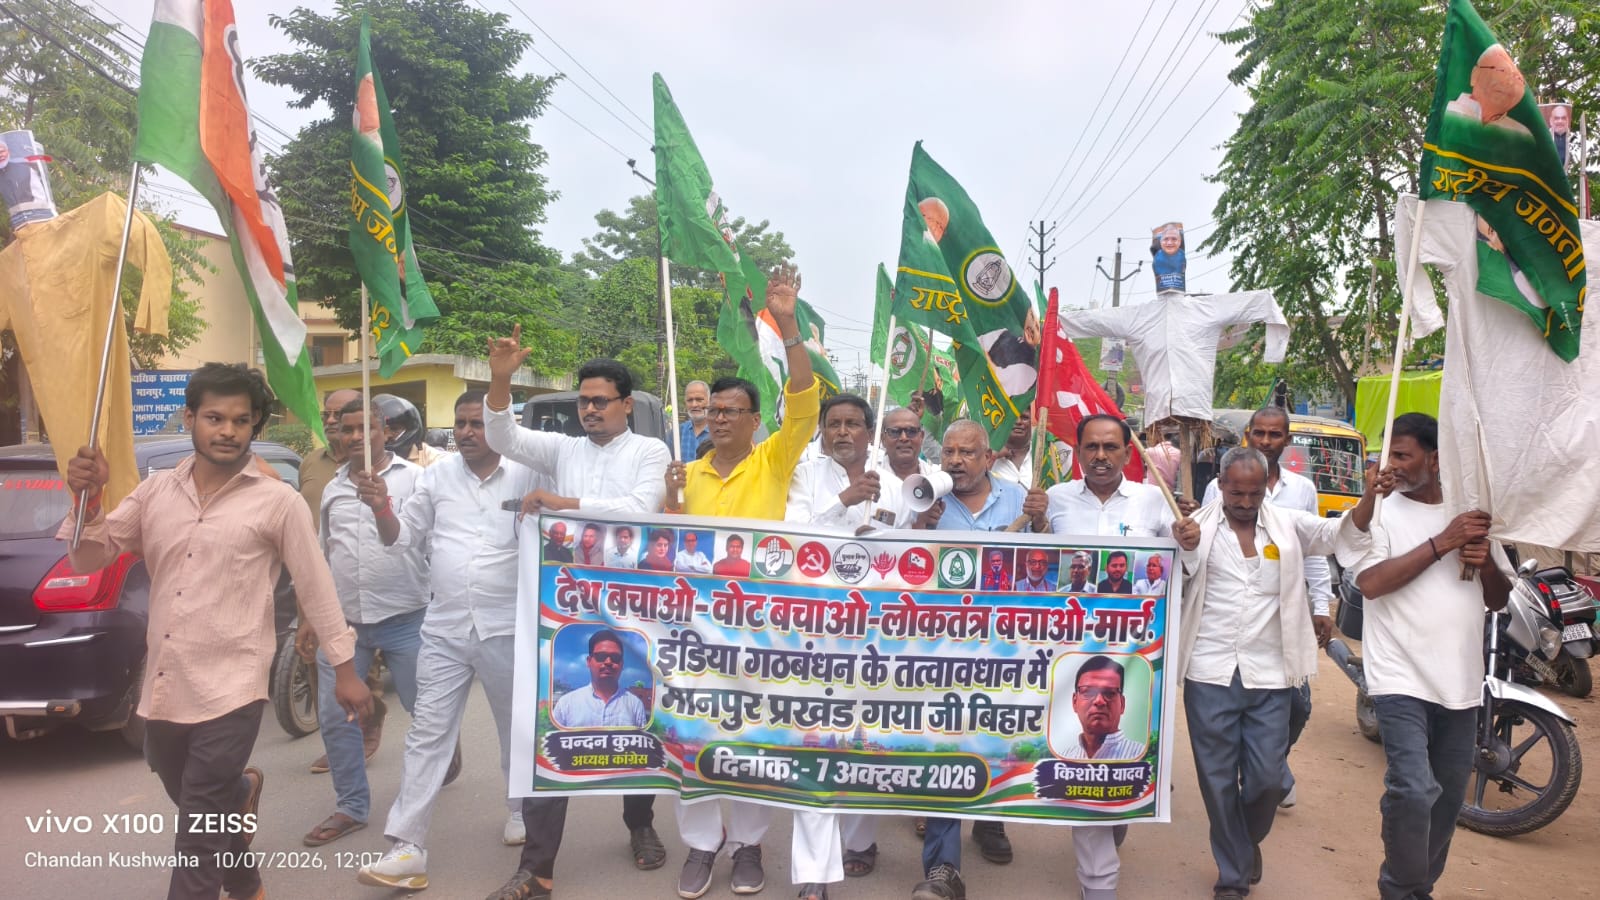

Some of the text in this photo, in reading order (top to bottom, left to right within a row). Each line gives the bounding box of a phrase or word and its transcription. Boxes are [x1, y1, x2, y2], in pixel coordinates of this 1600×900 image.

[1515, 191, 1586, 282] जनता
[556, 567, 602, 614] देश
[656, 629, 1053, 690] इंडिया गठबंधन के तत्वावधान में
[662, 684, 1044, 735] मानपुर प्रखंड गया जी बिहार
[560, 734, 656, 752] चन्दन कुमार
[571, 751, 648, 767] अध्यक्ष कांग्रेस
[817, 758, 830, 782] 7
[833, 761, 924, 793] अक्टूबर
[927, 764, 976, 790] 2026
[1053, 762, 1145, 782] किशोरी यादव
[1065, 785, 1134, 798] अध्यक्ष राजद
